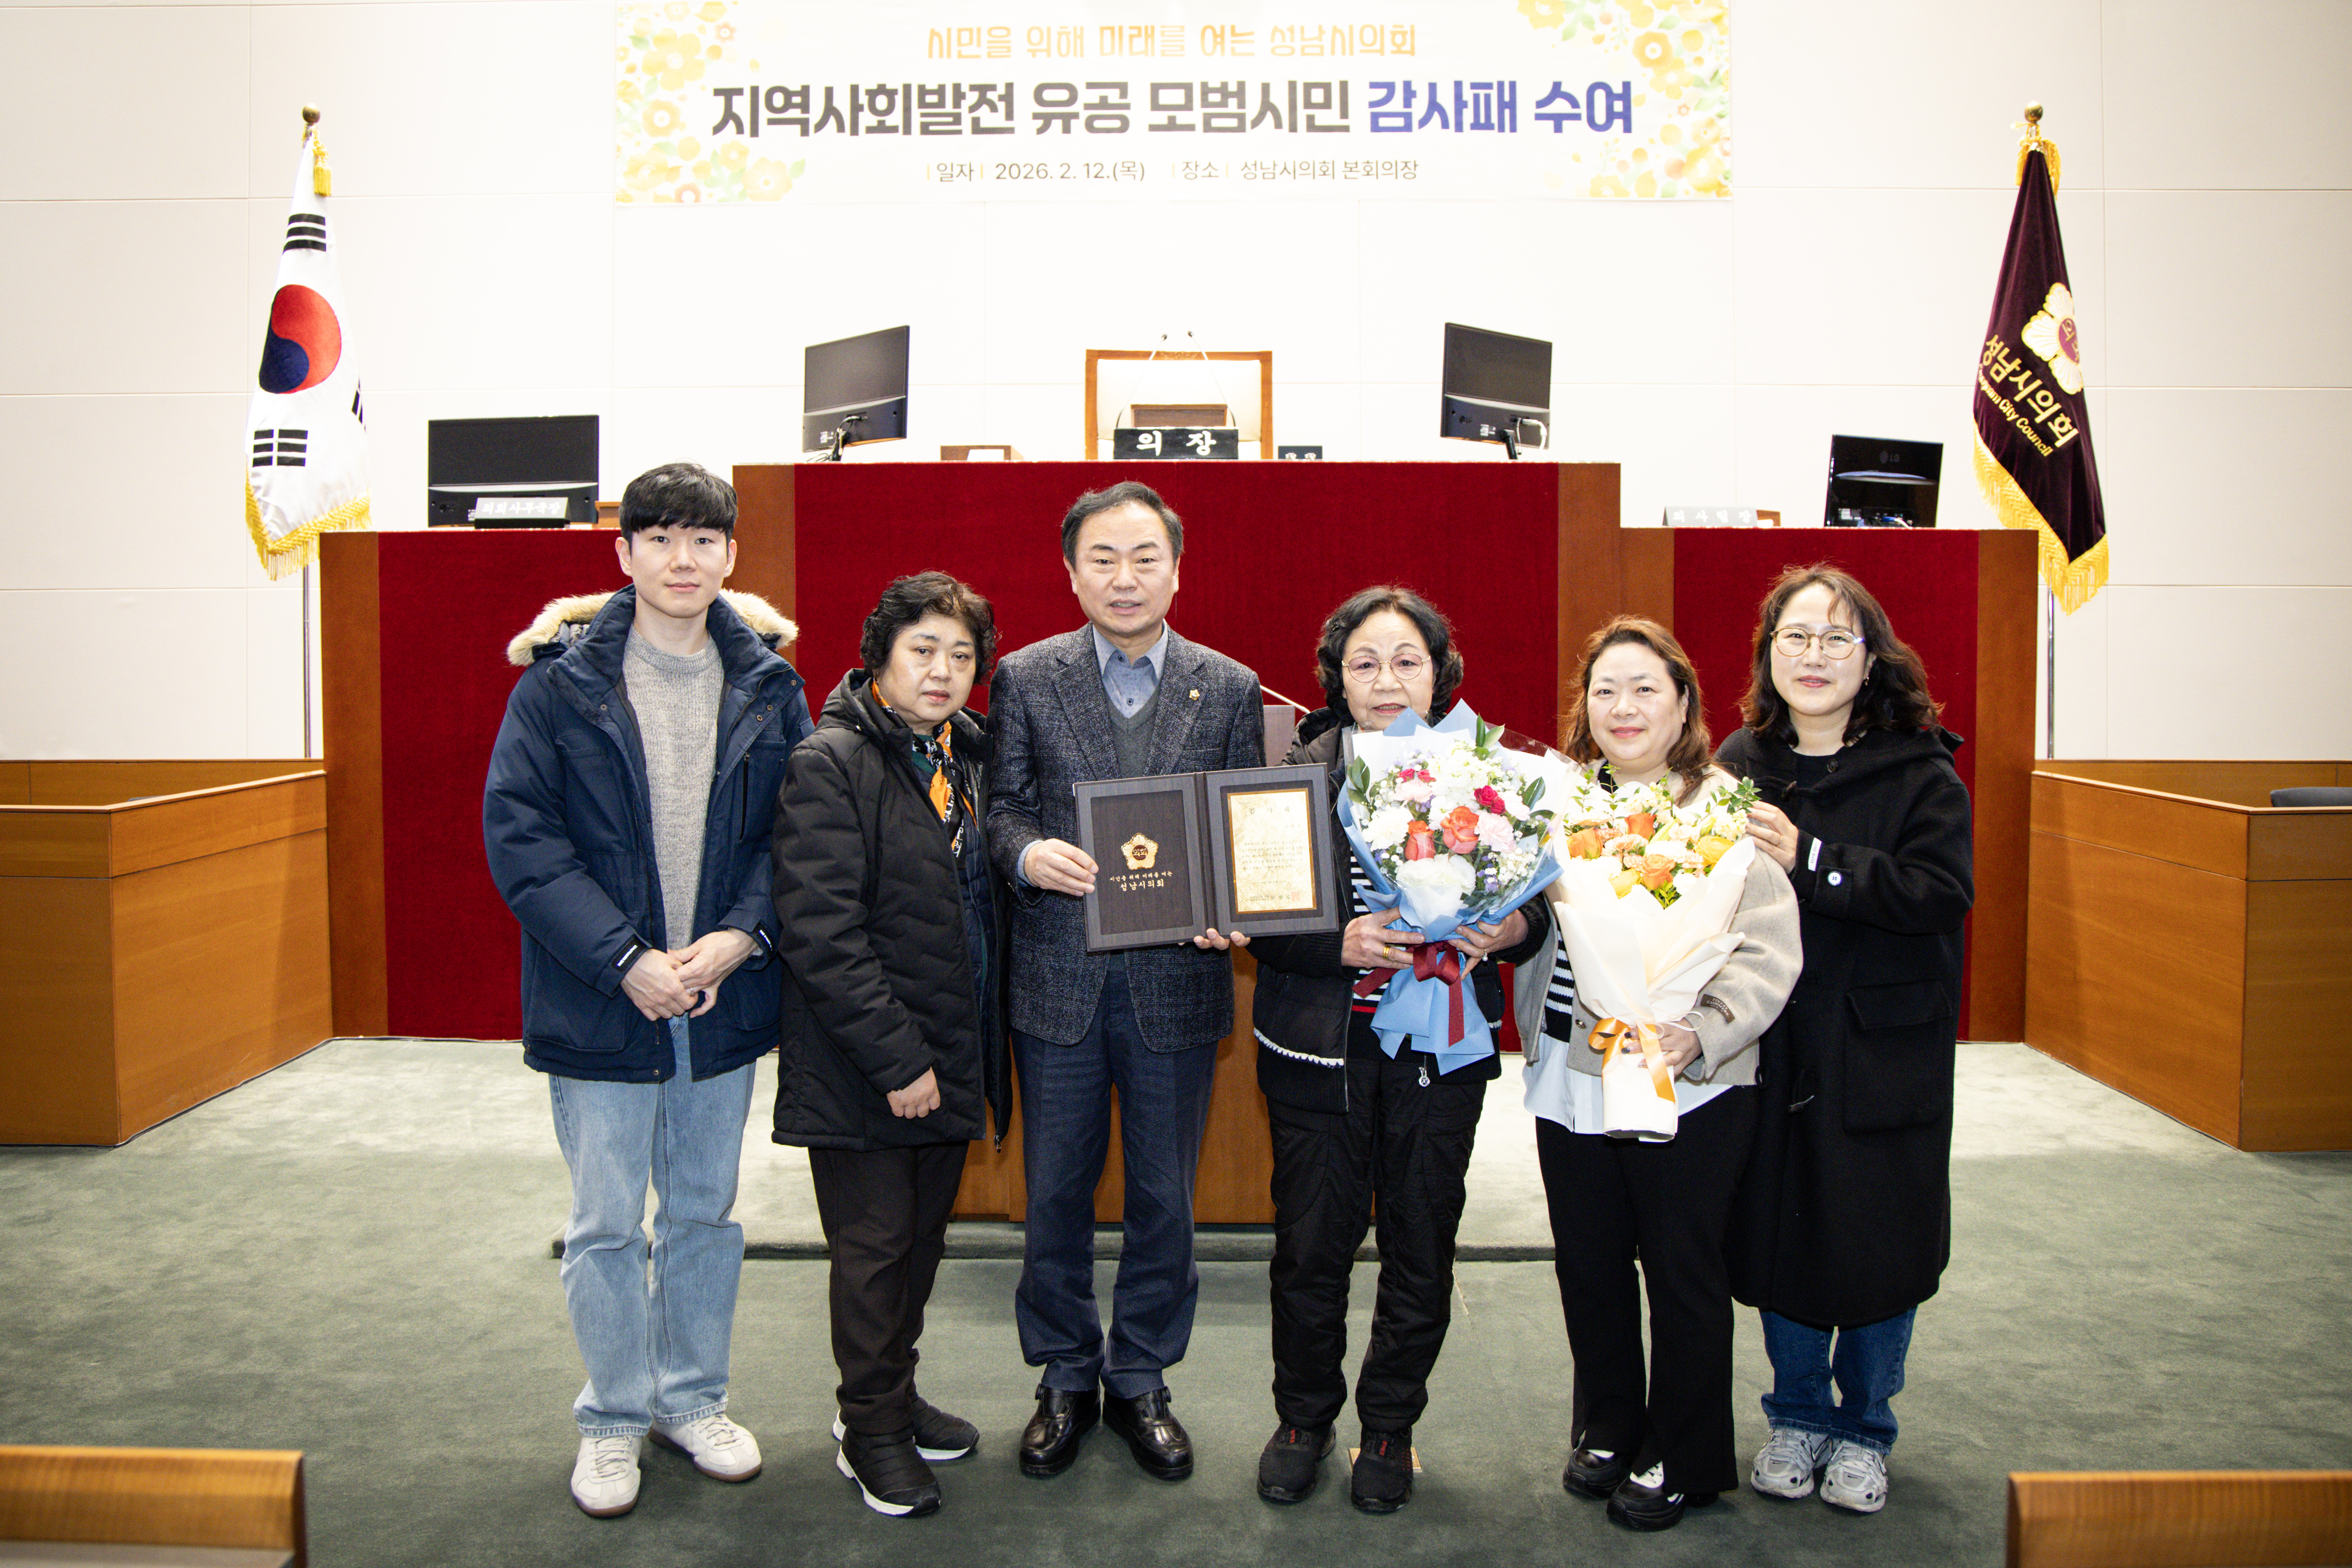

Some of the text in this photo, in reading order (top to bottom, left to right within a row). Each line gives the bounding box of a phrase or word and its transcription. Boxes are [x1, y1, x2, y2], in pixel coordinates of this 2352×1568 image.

[929, 25, 1416, 59] 시민을 위해 미래를 여는 성남시의회
[712, 81, 1632, 137] 지역사회발전 유공 모범시민 감사패 수여
[937, 162, 975, 183] 일자
[1182, 161, 1219, 180] 장소
[1241, 160, 1335, 180] 성남시의회
[1343, 160, 1419, 180] 본회의장
[1982, 335, 2079, 447] 성남시의회
[1999, 399, 2019, 421] City
[2016, 417, 2053, 457] Council
[481, 501, 561, 514] 의회사무국장
[1133, 847, 1147, 857] 의회
[1119, 878, 1164, 891] 성남시의회
[1707, 1001, 1729, 1016] CASHMERE
[1712, 998, 1728, 1010] FINEST
